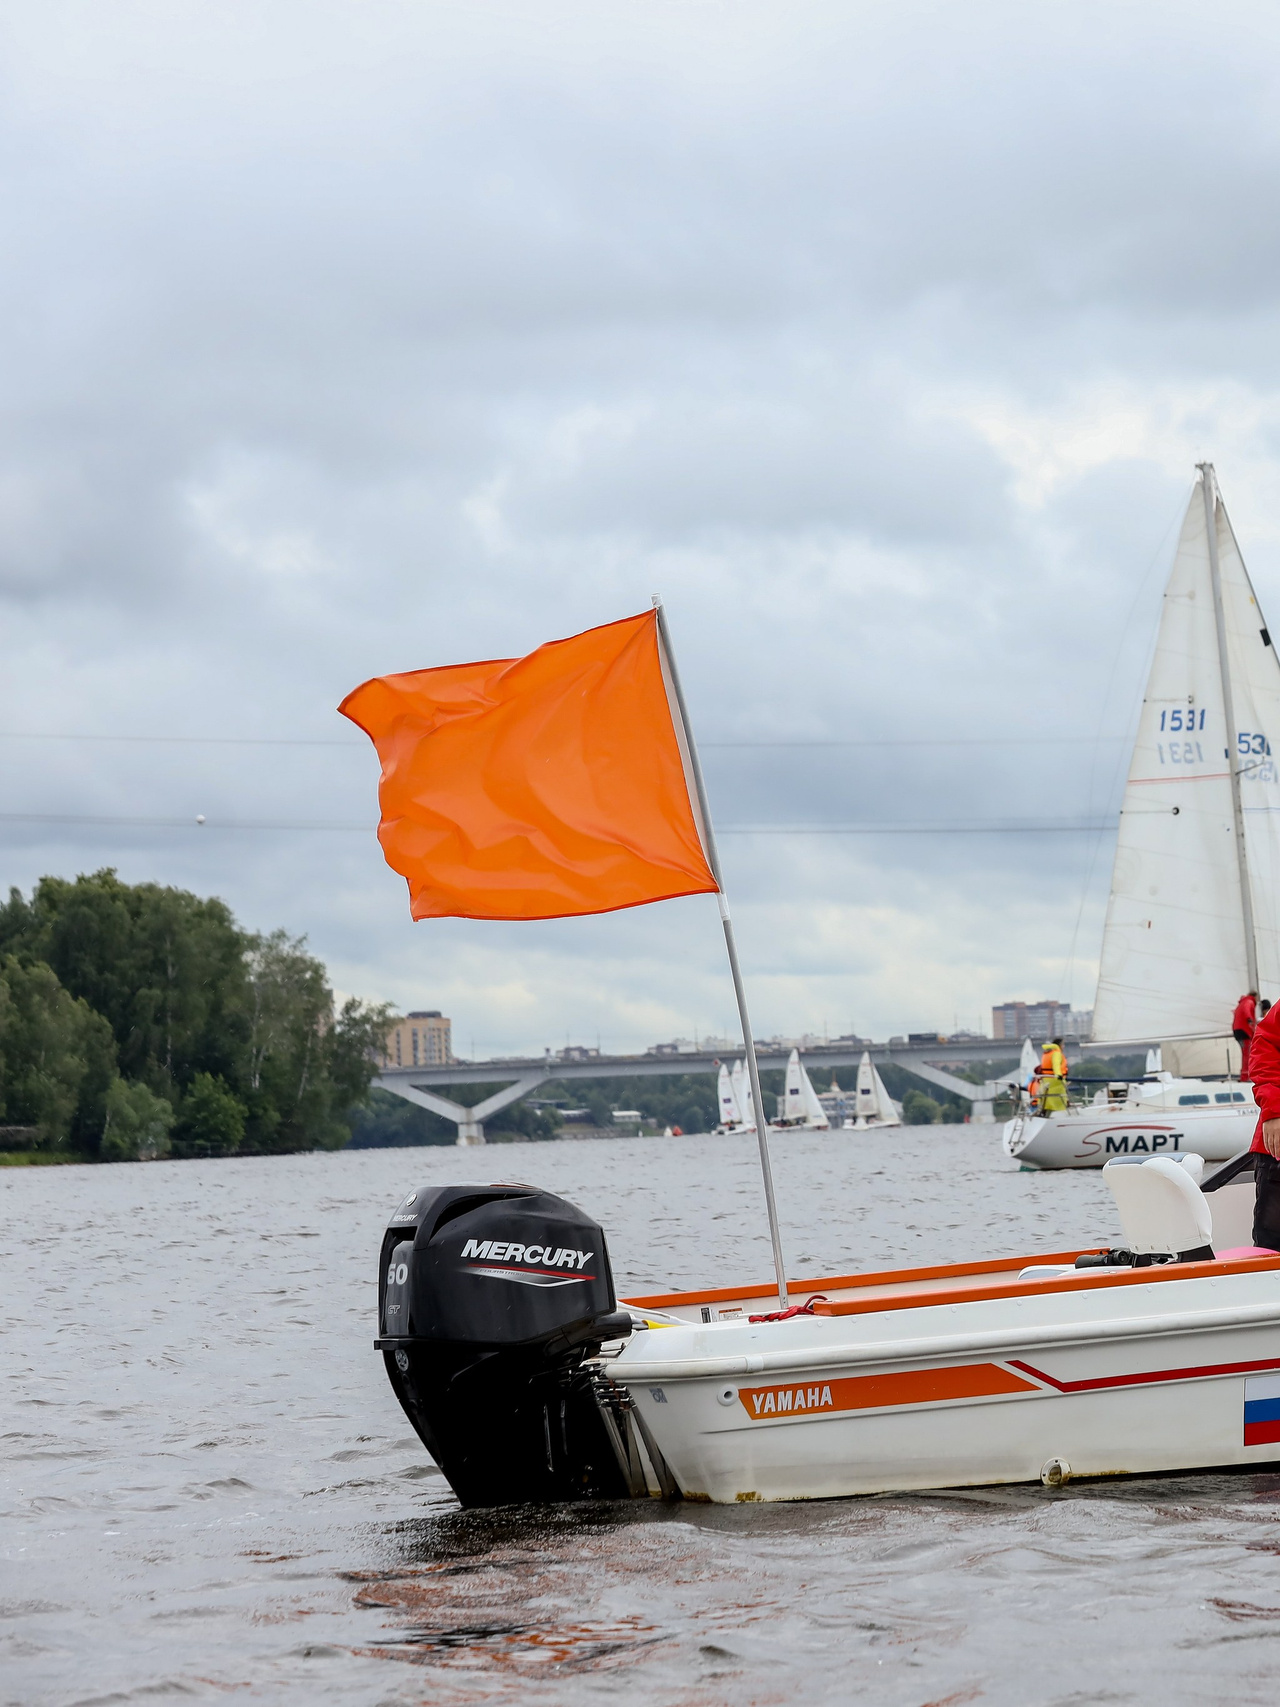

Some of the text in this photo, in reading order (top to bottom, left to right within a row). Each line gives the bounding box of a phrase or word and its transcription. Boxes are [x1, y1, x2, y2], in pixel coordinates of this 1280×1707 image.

[1160, 709, 1206, 732] 1531
[460, 1239, 594, 1269] MERCURY
[752, 1386, 833, 1414] YAMAHA
